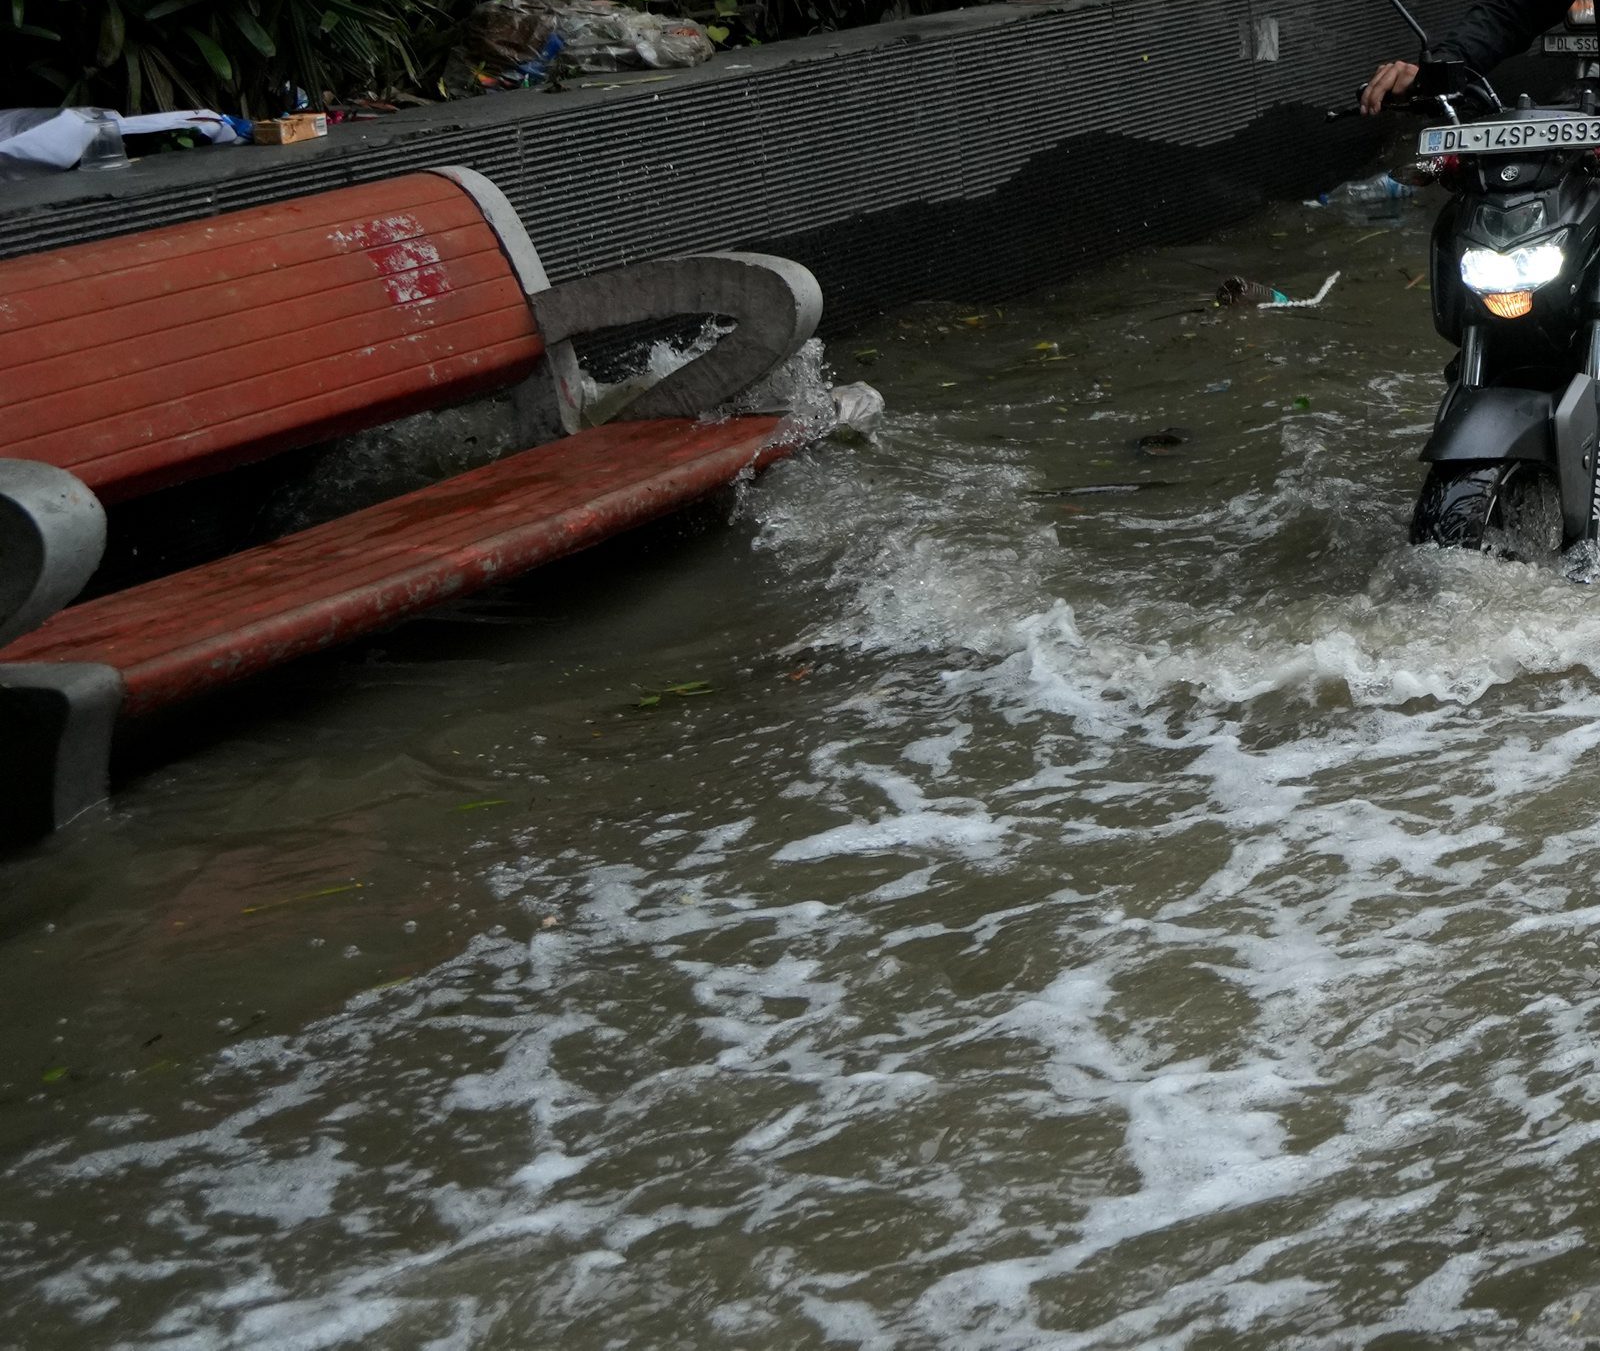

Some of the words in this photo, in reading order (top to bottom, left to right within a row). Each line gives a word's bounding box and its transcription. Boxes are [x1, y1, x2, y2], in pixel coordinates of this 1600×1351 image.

[1557, 38, 1571, 50] DL
[1444, 130, 1469, 151] DL
[1484, 124, 1536, 148] 14SP
